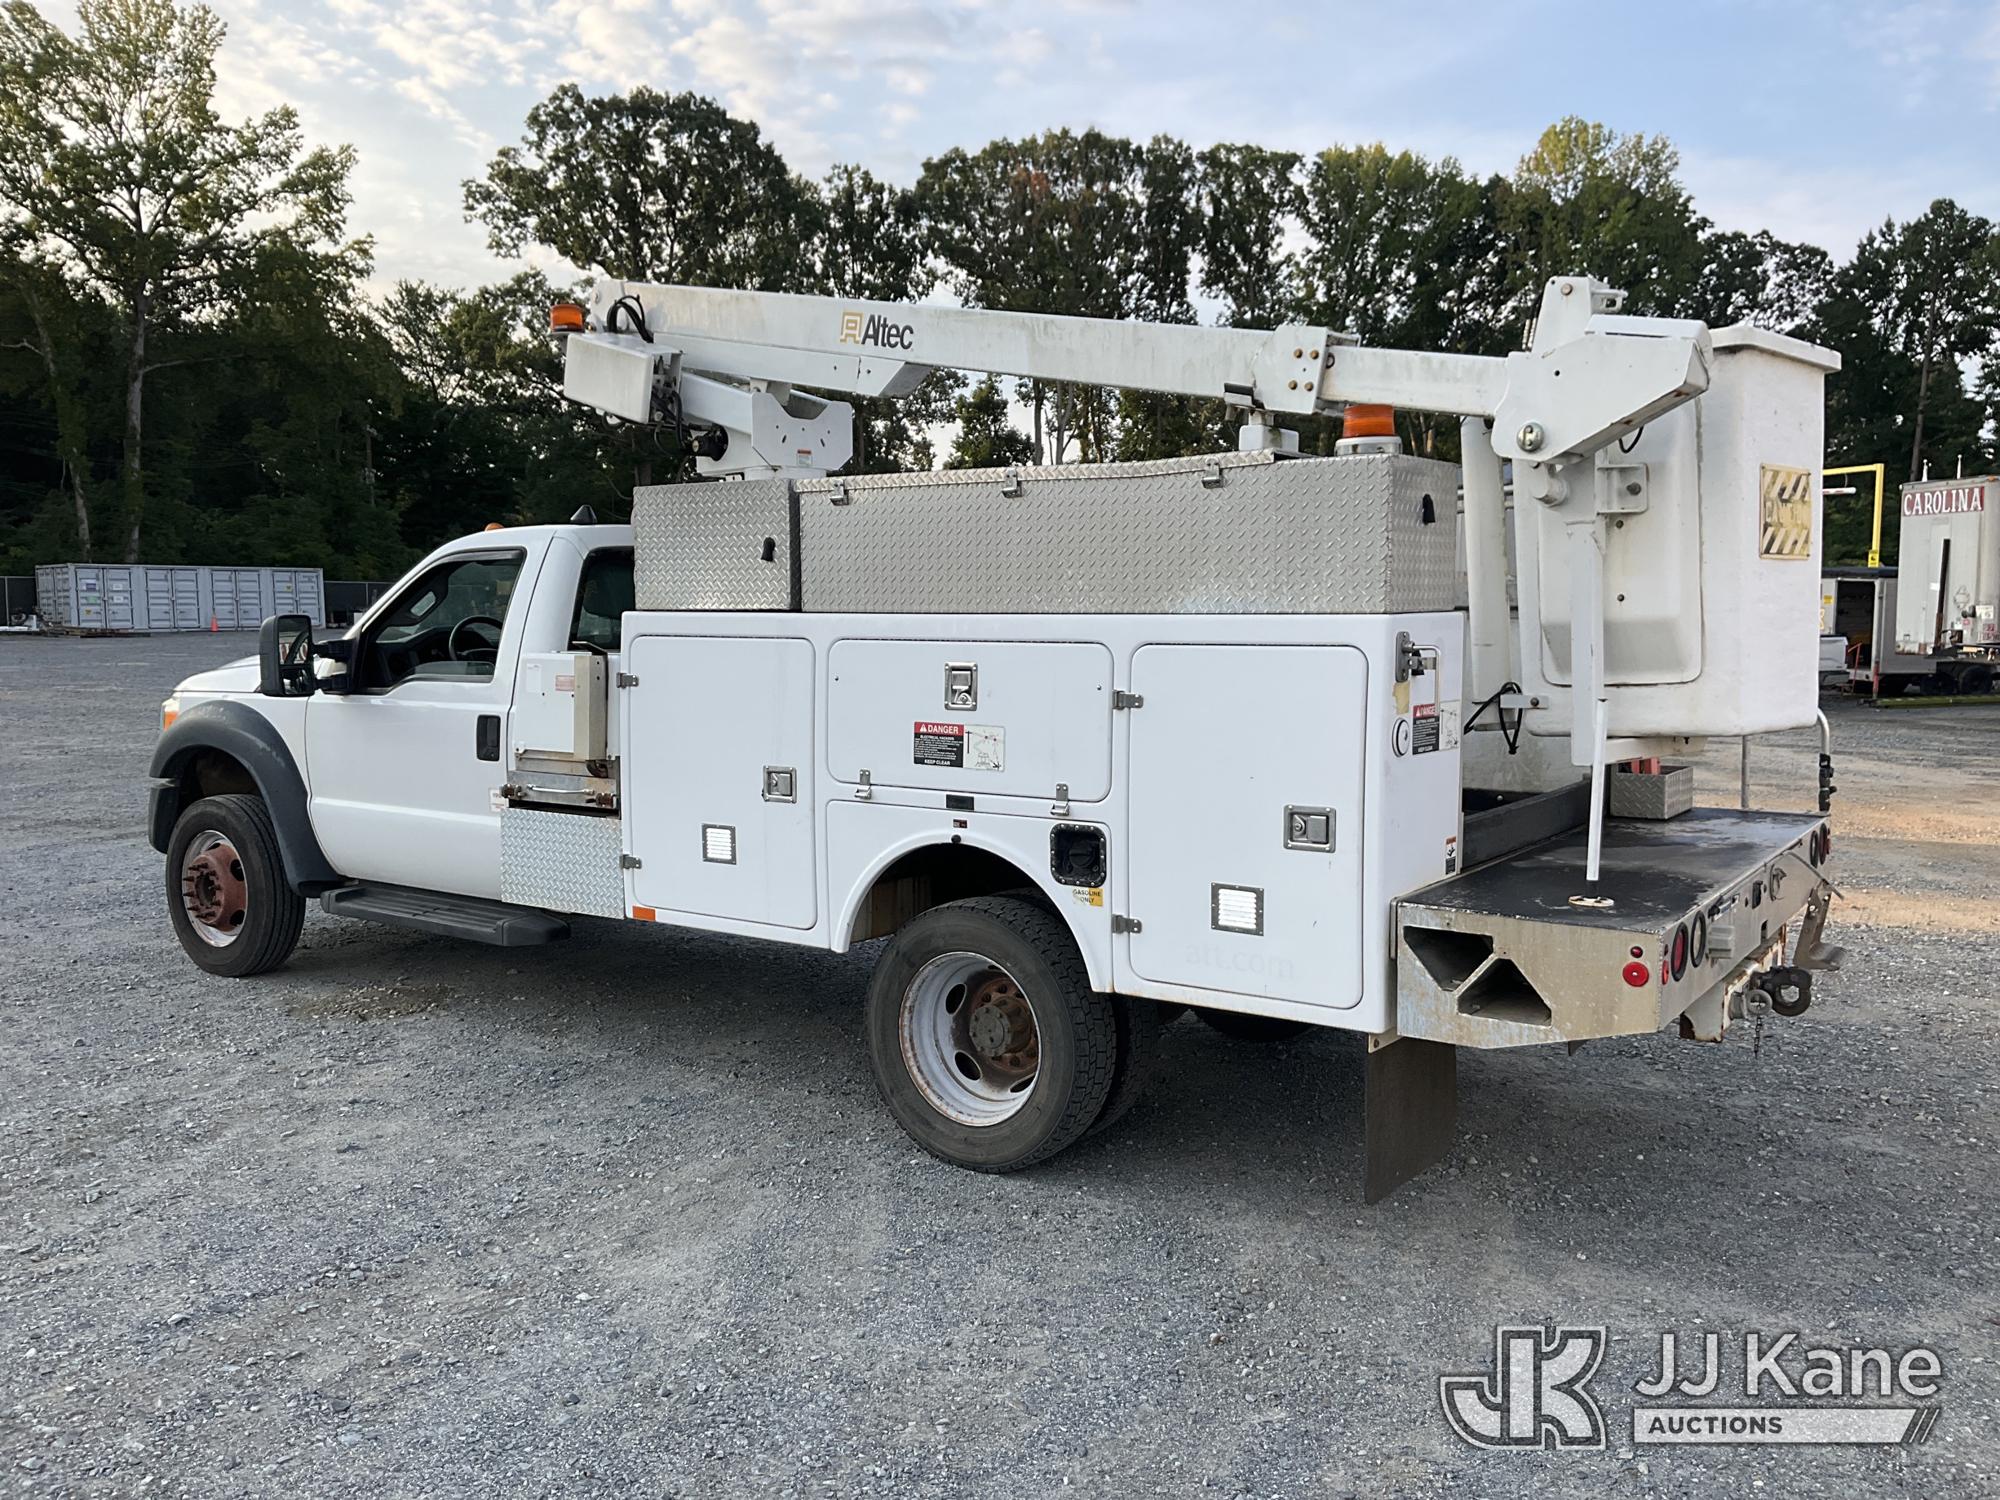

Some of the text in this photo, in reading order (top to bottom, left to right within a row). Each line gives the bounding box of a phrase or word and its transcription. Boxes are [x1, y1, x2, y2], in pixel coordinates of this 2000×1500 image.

[861, 314, 914, 350] Altec
[1903, 487, 1982, 516] CAROLINA
[927, 724, 959, 735] DANGER
[1072, 889, 1101, 897] GASOLINE
